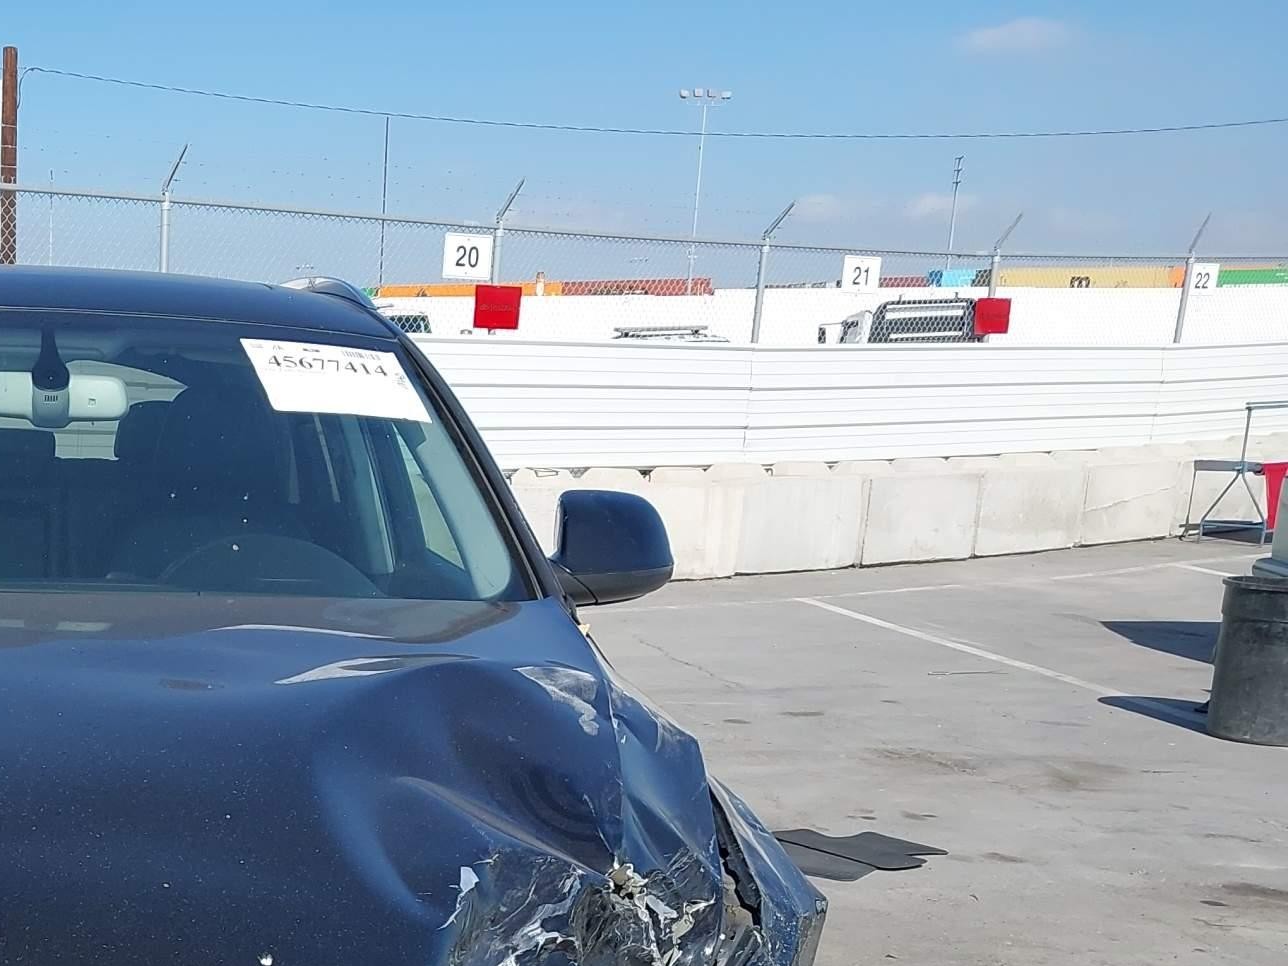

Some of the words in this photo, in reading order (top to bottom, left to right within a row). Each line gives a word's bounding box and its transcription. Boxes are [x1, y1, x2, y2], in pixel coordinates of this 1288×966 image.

[455, 245, 479, 268] 20
[852, 266, 870, 286] 21
[1194, 272, 1210, 289] 22
[268, 355, 388, 377] 45677414
